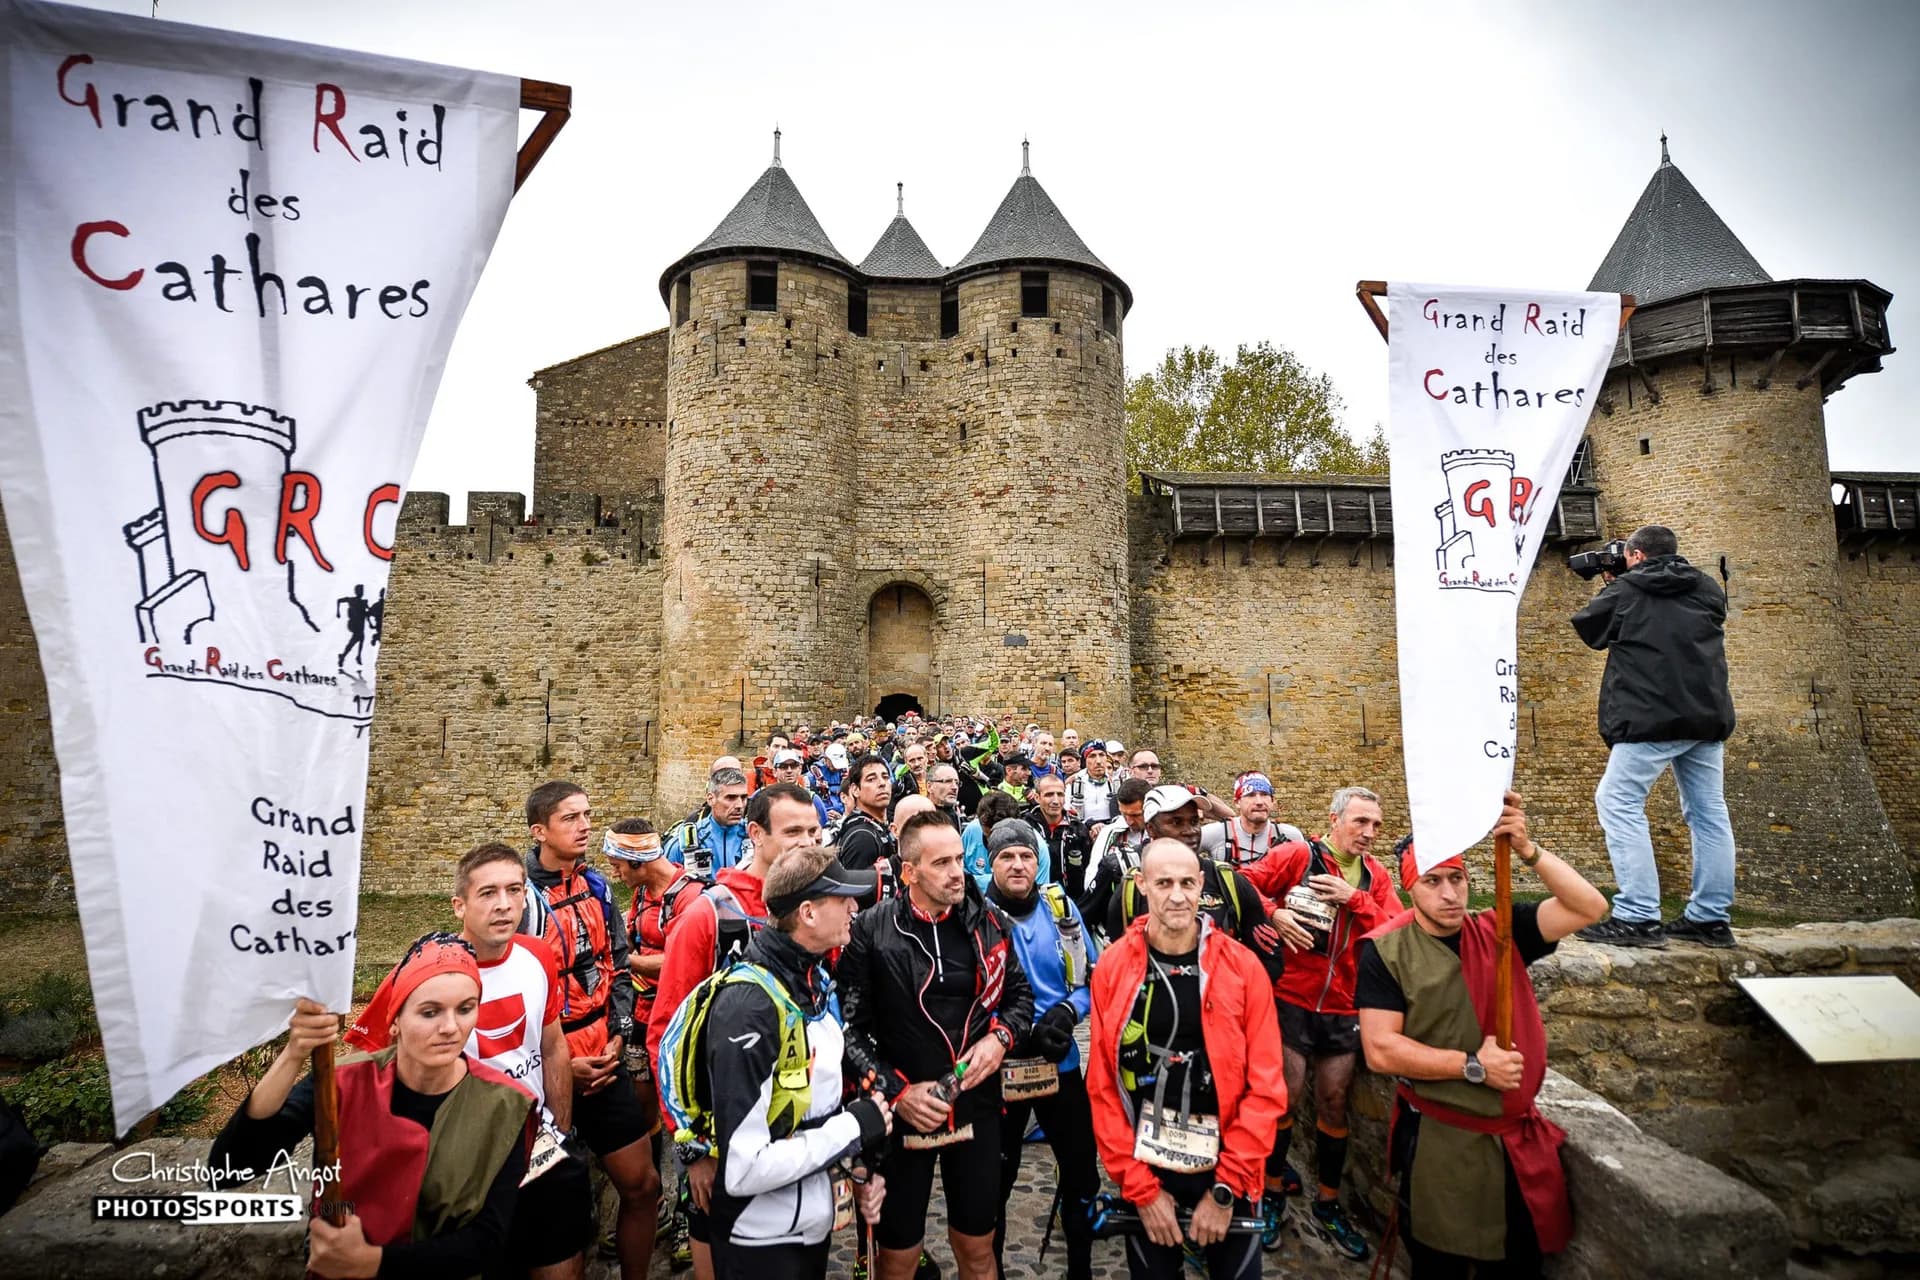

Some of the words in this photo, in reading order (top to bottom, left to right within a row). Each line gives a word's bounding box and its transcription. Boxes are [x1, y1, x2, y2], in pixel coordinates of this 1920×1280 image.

[56, 53, 264, 150] Grand
[312, 83, 446, 171] Raid
[227, 169, 301, 221] des
[71, 219, 430, 319] Cathares
[1423, 298, 1506, 335] Grand
[1524, 302, 1587, 339] Raid
[1484, 342, 1518, 366] des
[1423, 368, 1586, 410] Cathares
[242, 664, 264, 681] des
[267, 658, 338, 687] Cathares
[250, 796, 356, 836] Grand
[263, 840, 333, 877] Raid
[271, 888, 333, 918] des
[230, 923, 357, 956] Cathar
